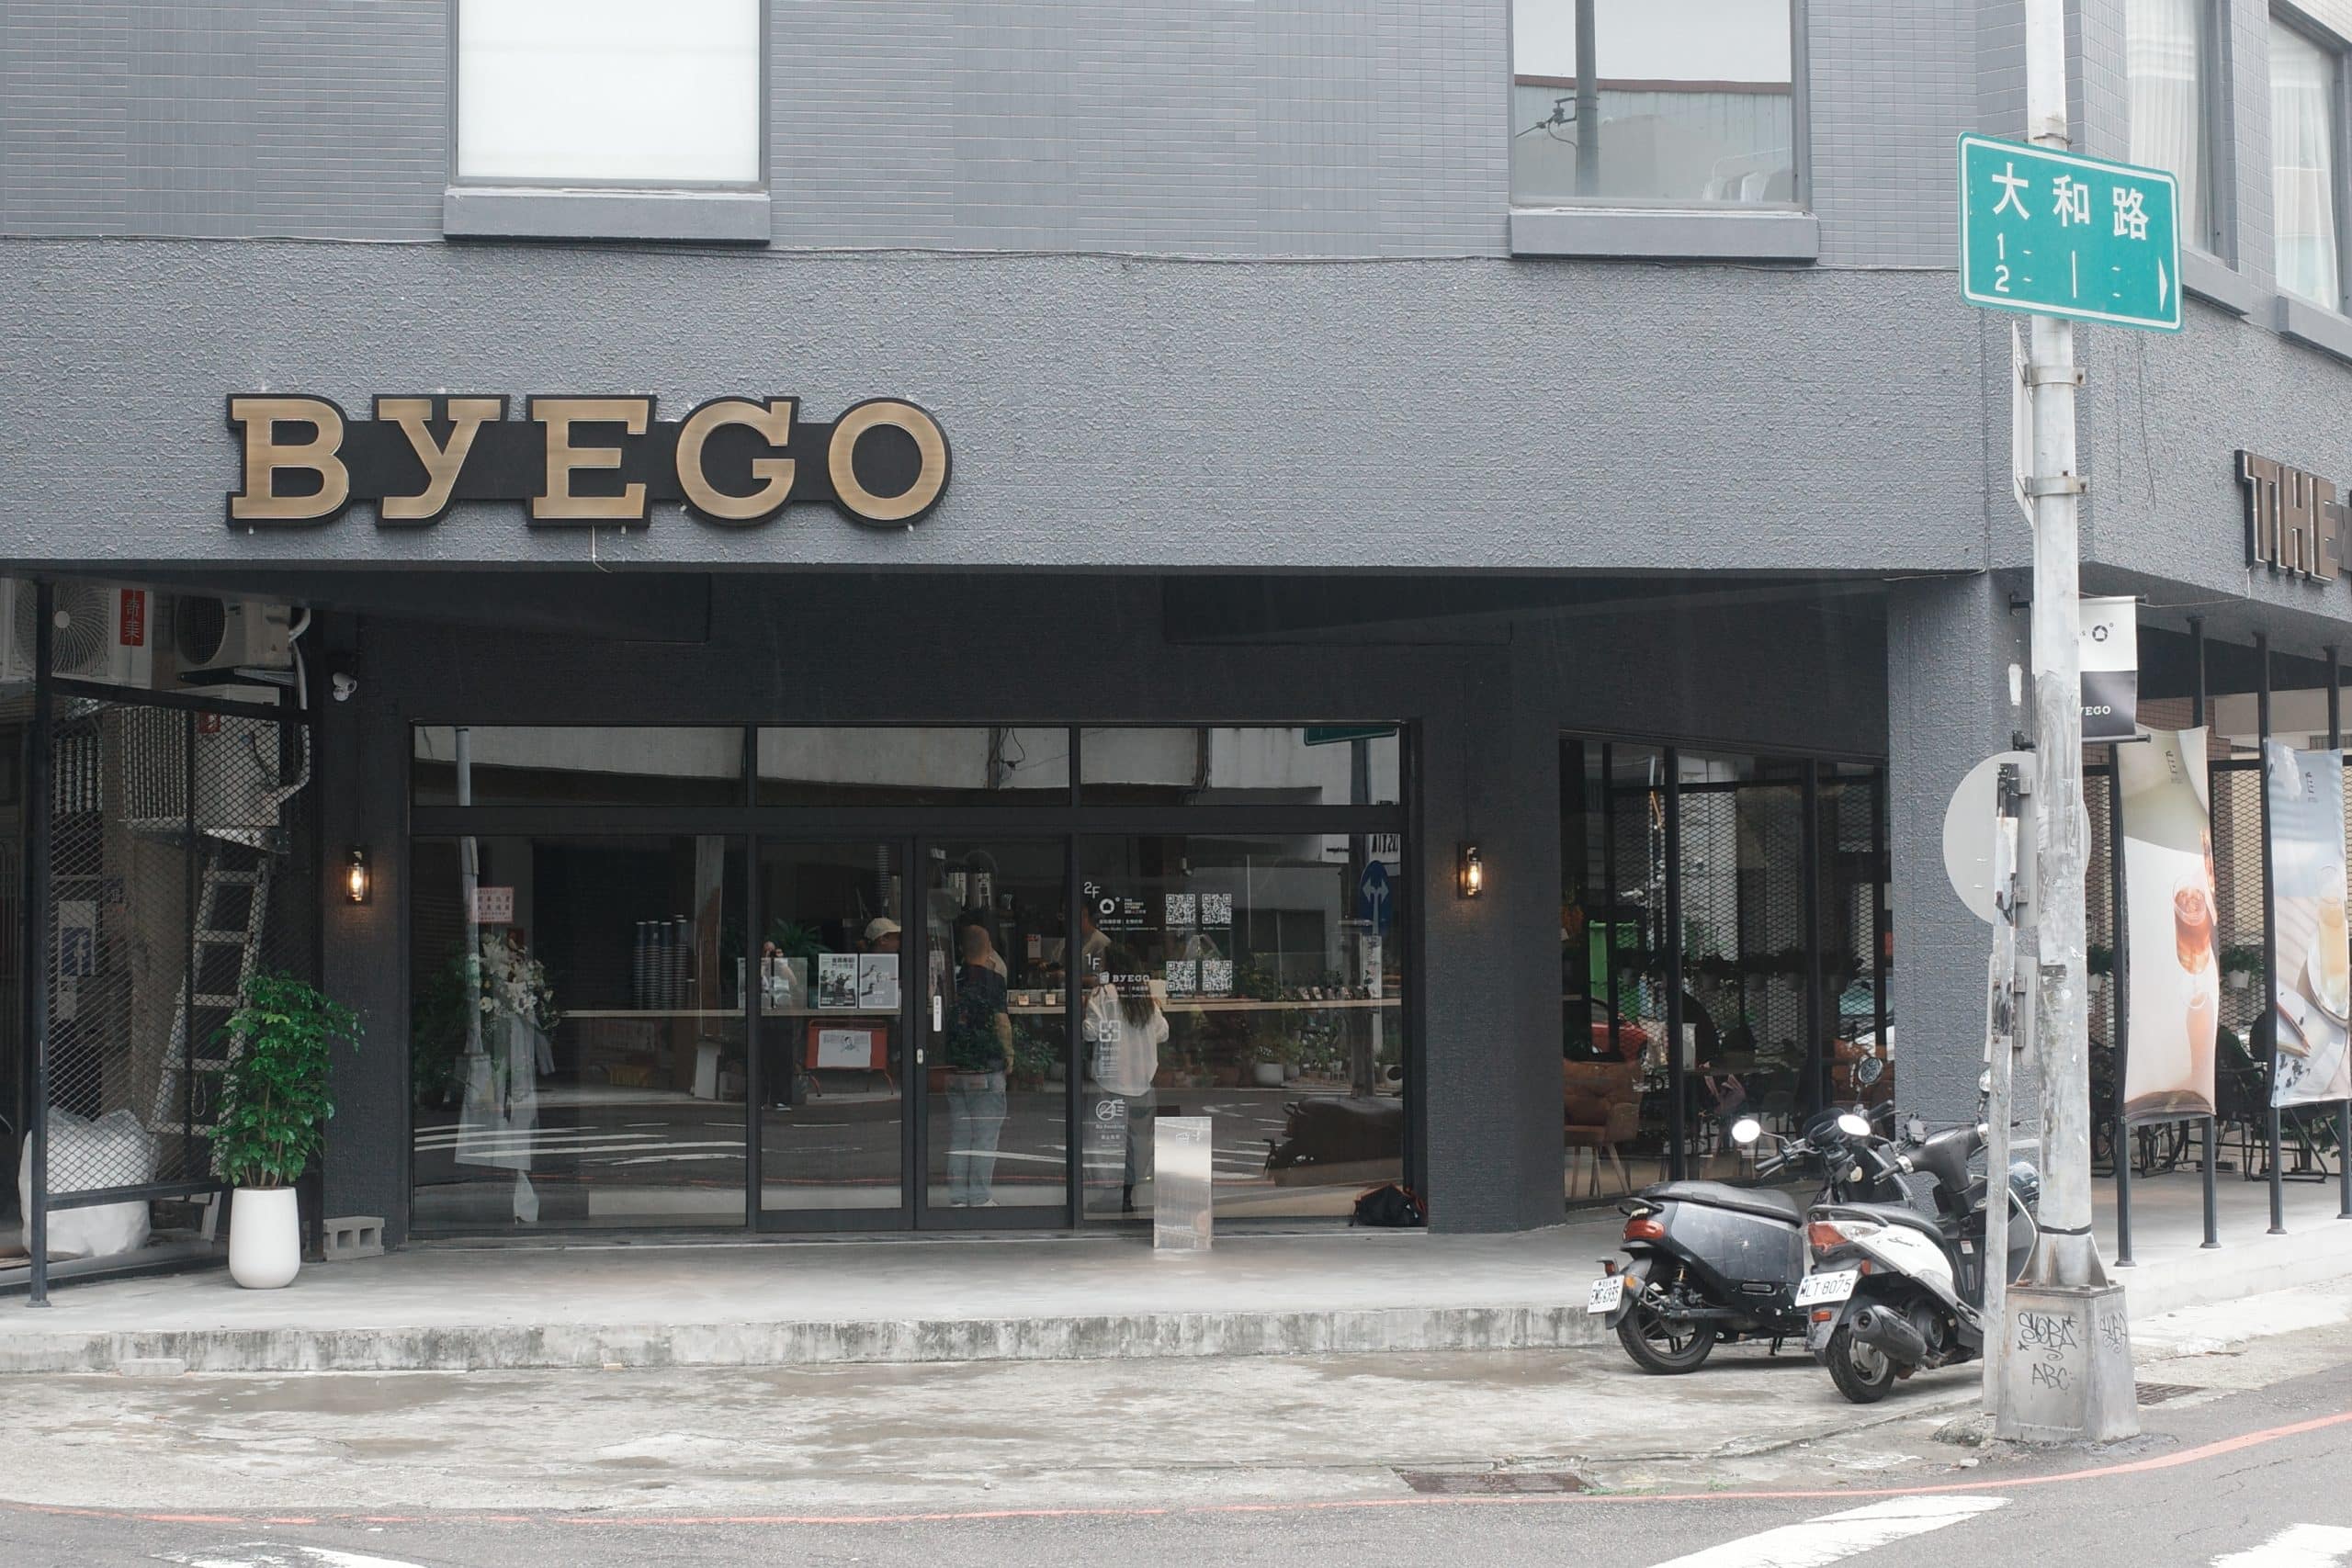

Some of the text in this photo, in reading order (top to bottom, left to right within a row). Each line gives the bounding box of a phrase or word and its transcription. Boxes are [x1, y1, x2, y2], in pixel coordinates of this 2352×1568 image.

[1991, 162, 2149, 241] 大和路
[229, 396, 948, 523] BYEGO
[2238, 451, 2339, 581] THE
[2080, 705, 2111, 716] EGO
[1083, 881, 1101, 899] 2F
[1086, 953, 1102, 971] 1F
[1112, 974, 1150, 983] BYEGO
